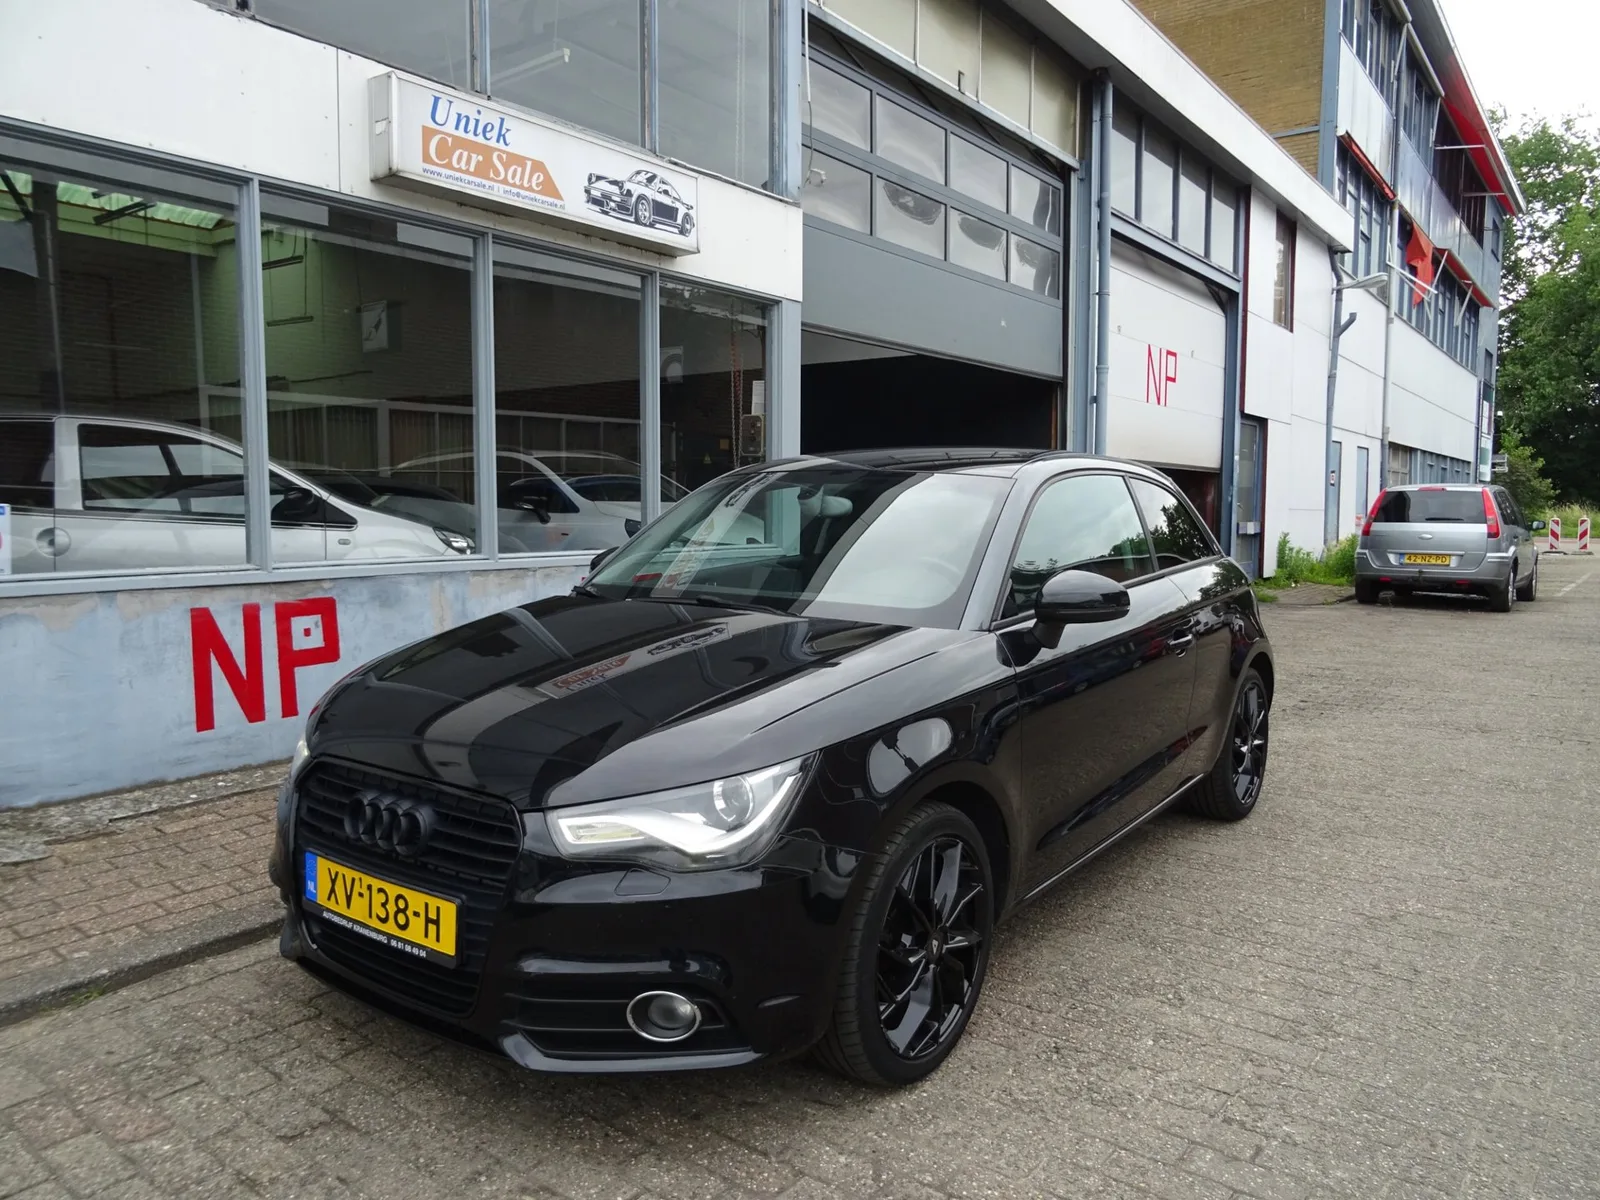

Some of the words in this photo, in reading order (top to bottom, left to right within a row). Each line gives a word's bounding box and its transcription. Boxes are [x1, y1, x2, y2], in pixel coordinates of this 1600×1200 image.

[430, 94, 512, 146] Uniek
[422, 166, 495, 192] www.uniekcarsale.nl
[502, 187, 566, 210] info@uniekcarsale.nl
[429, 133, 484, 171] Car
[489, 151, 544, 192] Sale
[1146, 343, 1178, 407] NP
[1406, 555, 1448, 563] 42-NZ-PD
[190, 596, 340, 733] NP
[327, 867, 441, 943] XV-138-H
